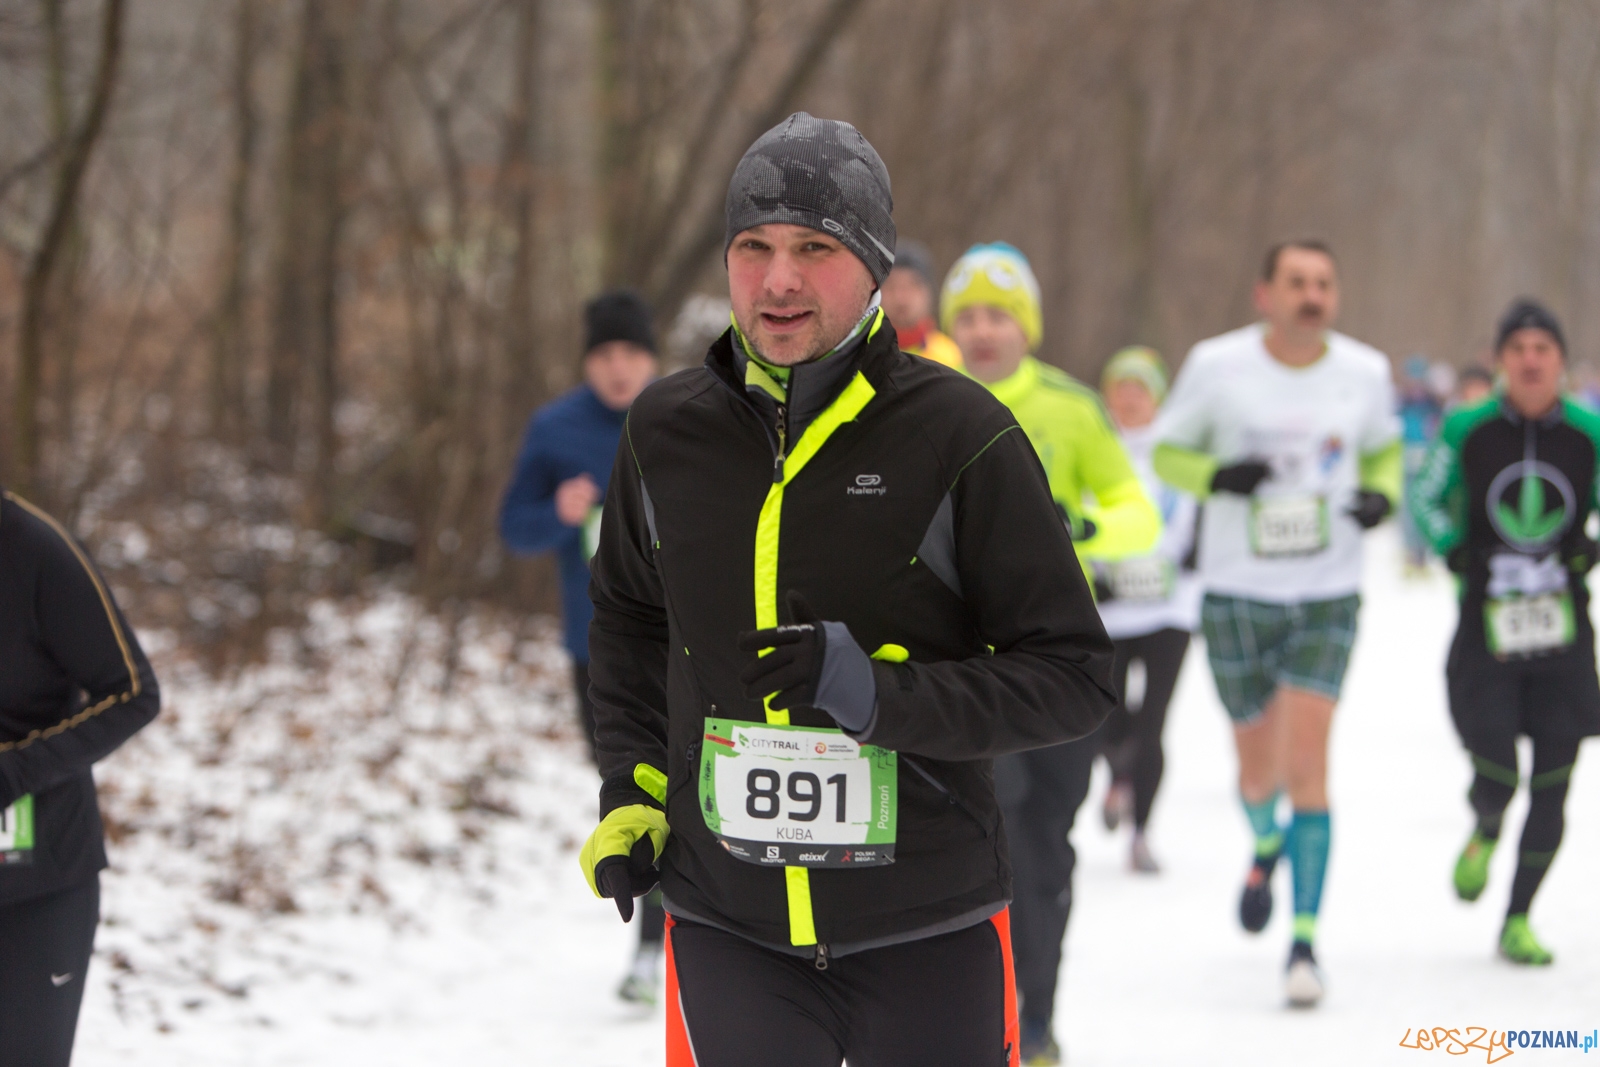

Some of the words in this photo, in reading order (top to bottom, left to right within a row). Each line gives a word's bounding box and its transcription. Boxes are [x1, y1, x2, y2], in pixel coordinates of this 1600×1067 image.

[846, 486, 887, 496] Kalenji
[745, 768, 847, 823] 891
[877, 785, 890, 830] Poznań
[776, 827, 814, 841] KUBA
